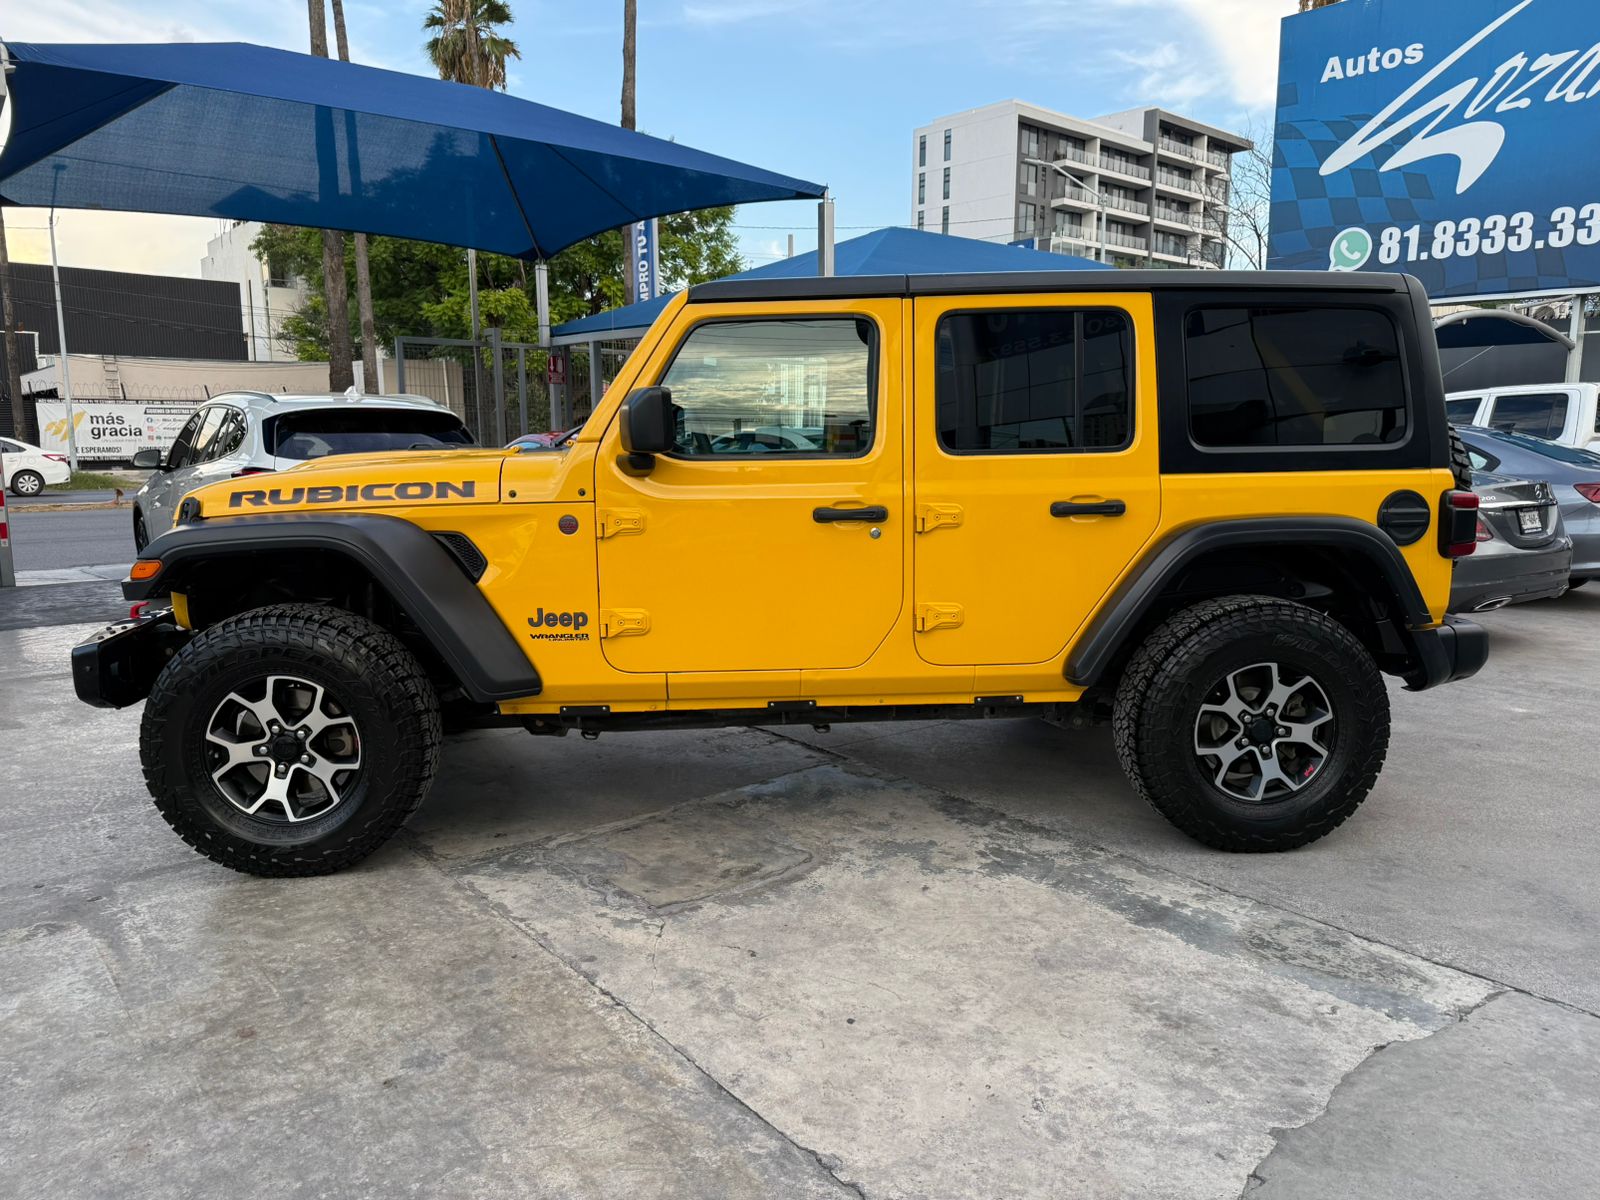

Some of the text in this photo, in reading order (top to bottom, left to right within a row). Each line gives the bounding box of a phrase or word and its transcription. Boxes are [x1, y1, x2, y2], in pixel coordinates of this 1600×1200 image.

[1319, 42, 1425, 84] Autos
[1378, 202, 1600, 265] 81.8333.33
[637, 235, 648, 257] TU
[90, 412, 125, 425] más
[91, 425, 143, 440] gracia
[228, 480, 476, 509] RUBICON
[527, 607, 589, 630] Jeep
